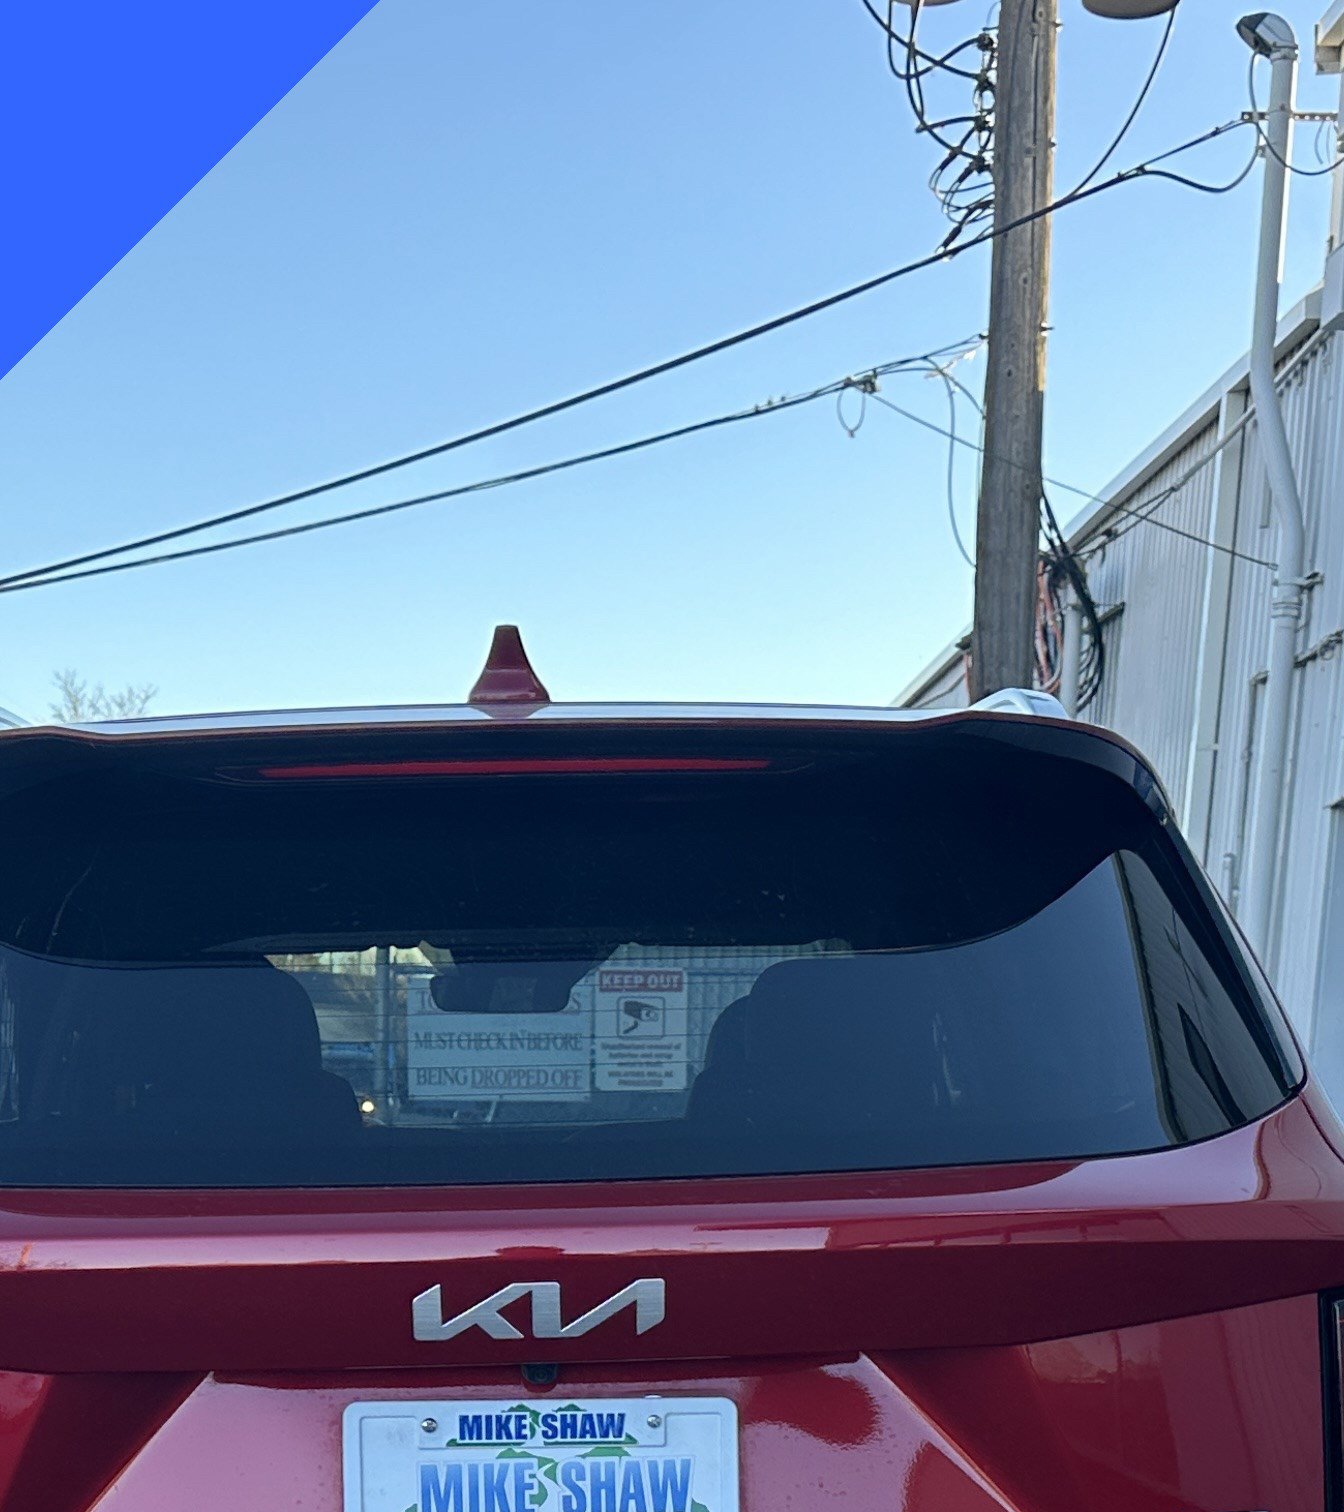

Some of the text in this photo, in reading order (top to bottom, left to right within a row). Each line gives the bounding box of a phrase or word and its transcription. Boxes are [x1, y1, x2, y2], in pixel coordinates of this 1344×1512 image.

[601, 973, 681, 989] KEEP OUT
[414, 1031, 455, 1051] MUST
[457, 1031, 507, 1051] CHECK
[526, 1032, 584, 1051] BEFORE
[415, 1067, 584, 1088] BEING DROPPED OFF
[412, 1277, 666, 1341] KIA
[458, 1412, 626, 1441] MIKE SHAW
